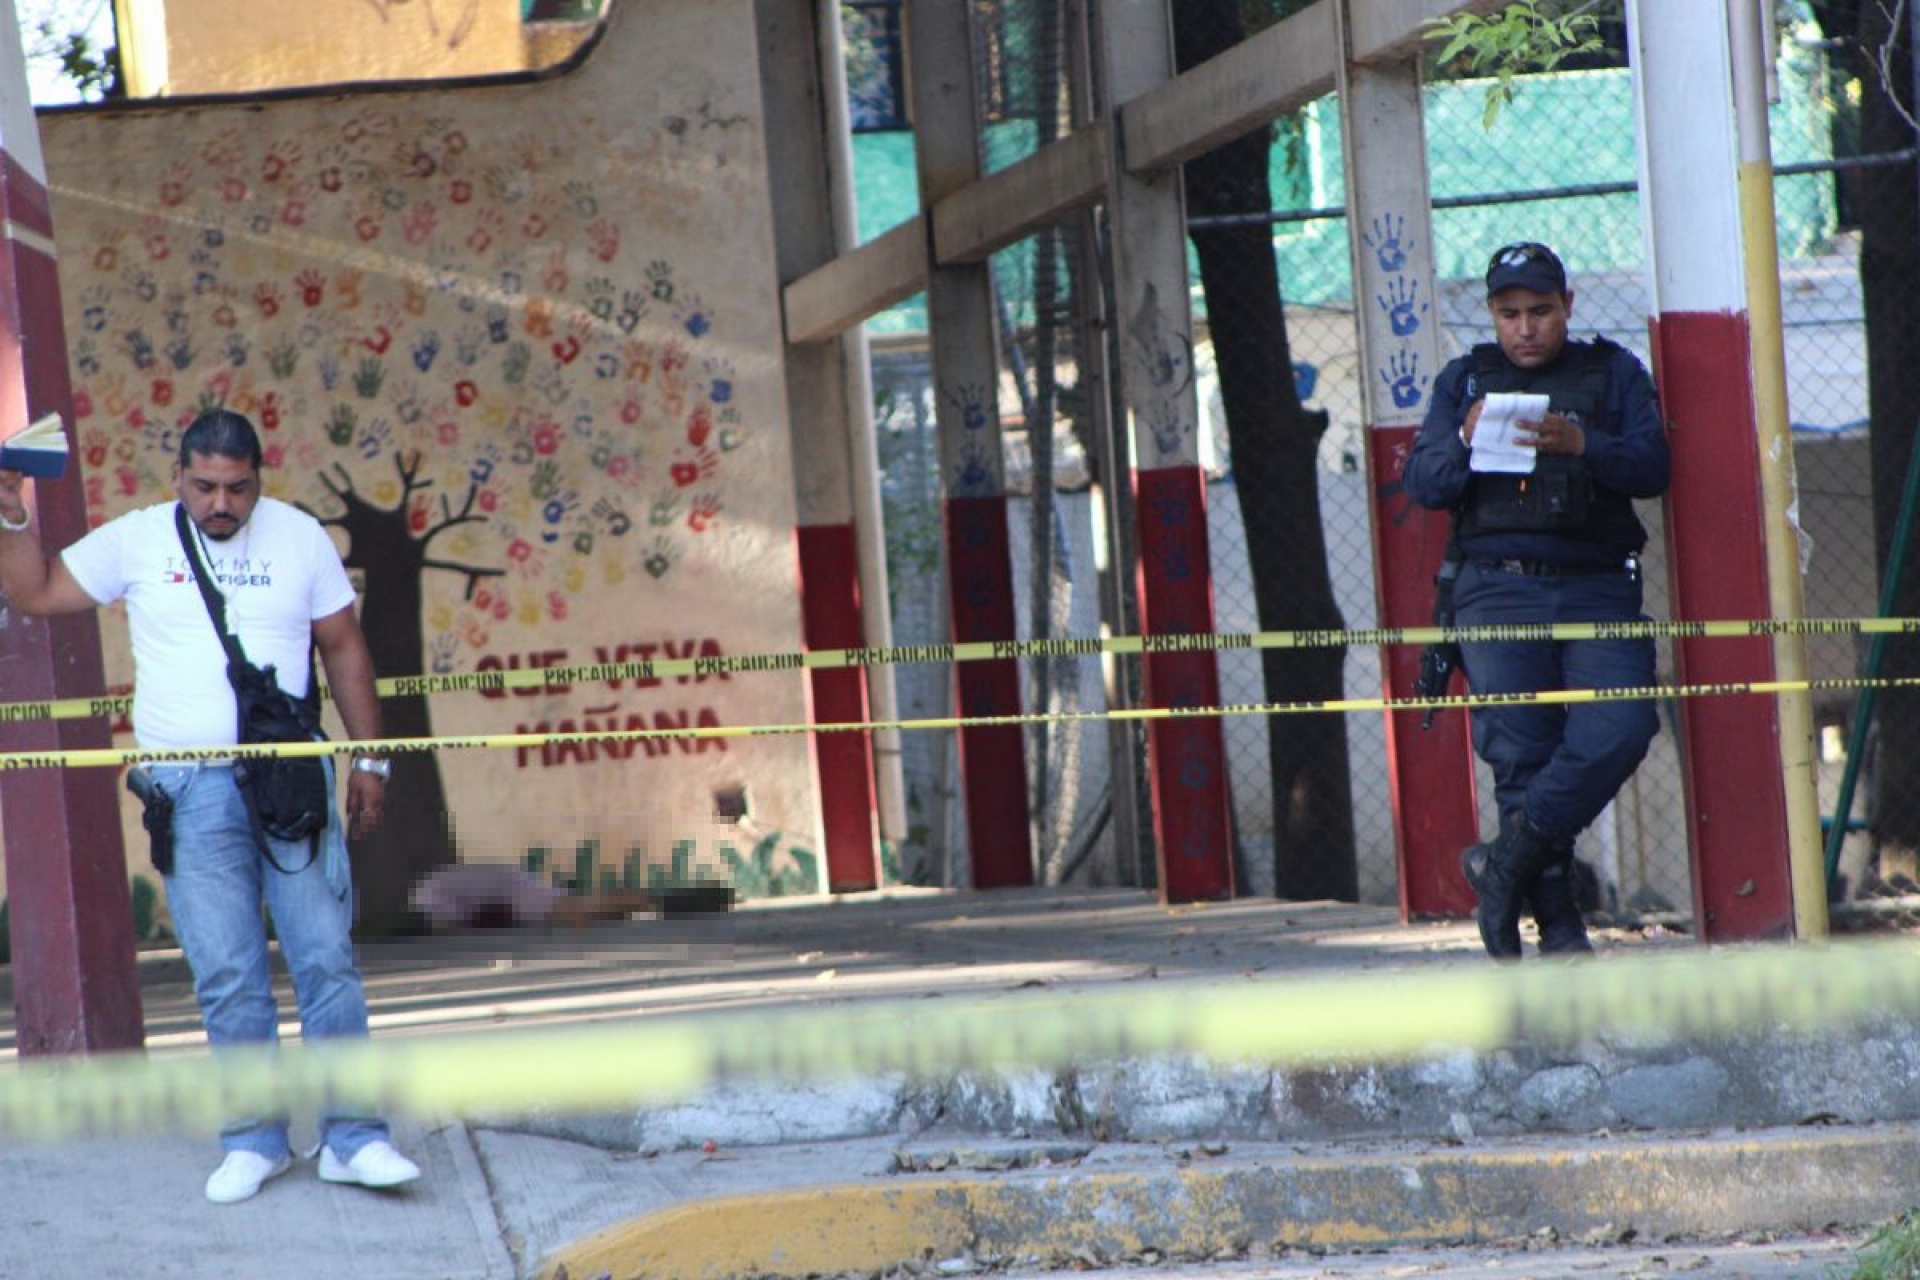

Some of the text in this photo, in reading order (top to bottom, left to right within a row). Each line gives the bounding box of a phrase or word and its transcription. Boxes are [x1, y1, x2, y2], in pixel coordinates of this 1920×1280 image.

[188, 573, 271, 587] HFIGER
[394, 672, 505, 697] PRECAUCION
[543, 662, 655, 686] PRECAUCION
[694, 652, 804, 674] PRECAUCION
[845, 647, 953, 666] PRECAUCION
[993, 638, 1102, 660] PRECAUCION
